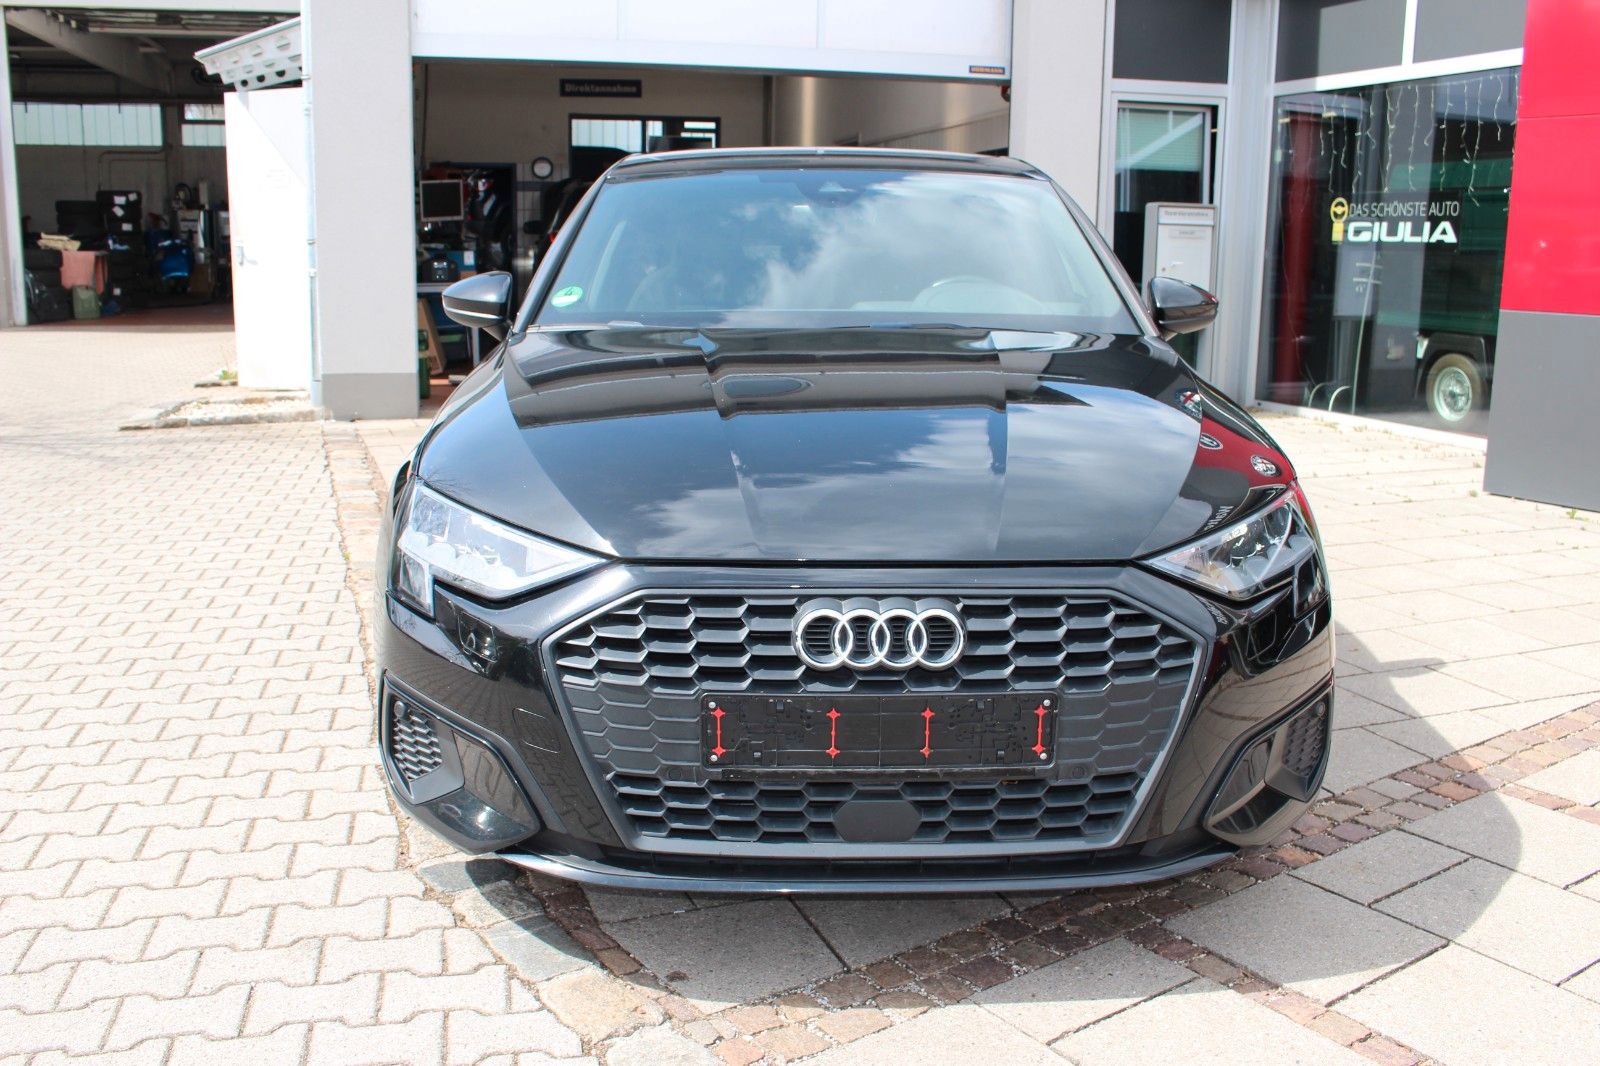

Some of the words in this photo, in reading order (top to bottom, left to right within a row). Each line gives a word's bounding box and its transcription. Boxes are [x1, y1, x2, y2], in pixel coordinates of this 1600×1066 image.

[565, 83, 637, 92] Direktannahme
[1349, 203, 1369, 217] DAS
[1371, 201, 1427, 217] SCHÖNSTE
[1429, 201, 1460, 216] AUTO
[1347, 221, 1458, 243] GIULIA
